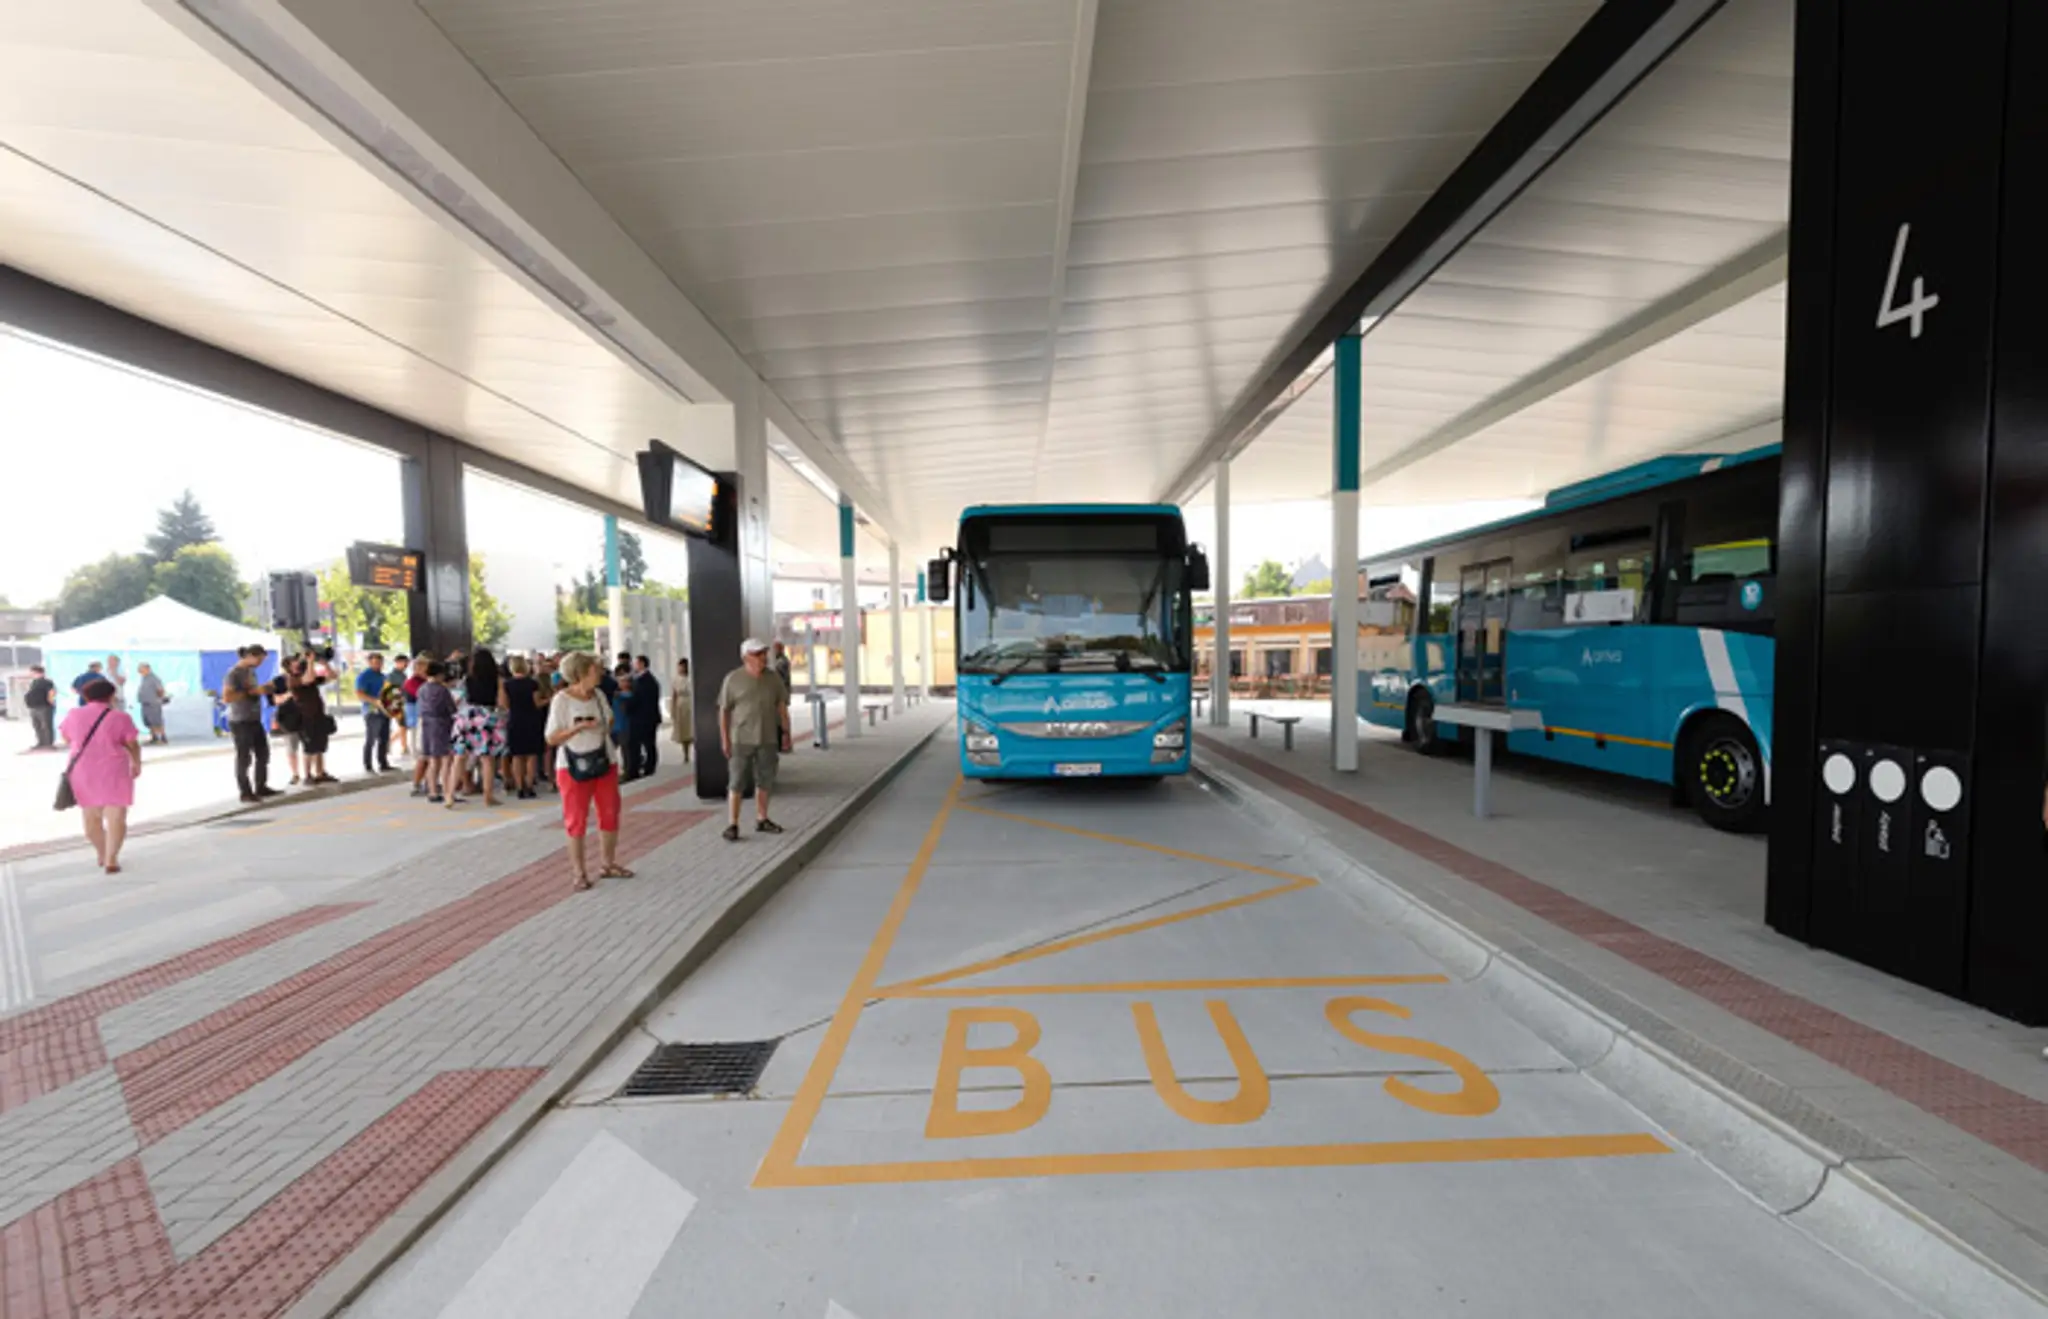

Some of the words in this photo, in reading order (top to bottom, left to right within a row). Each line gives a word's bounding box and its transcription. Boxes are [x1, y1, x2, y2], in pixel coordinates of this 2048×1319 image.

[1876, 222, 1940, 338] 4
[1593, 649, 1622, 663] ava
[925, 996, 1500, 1138] BUS
